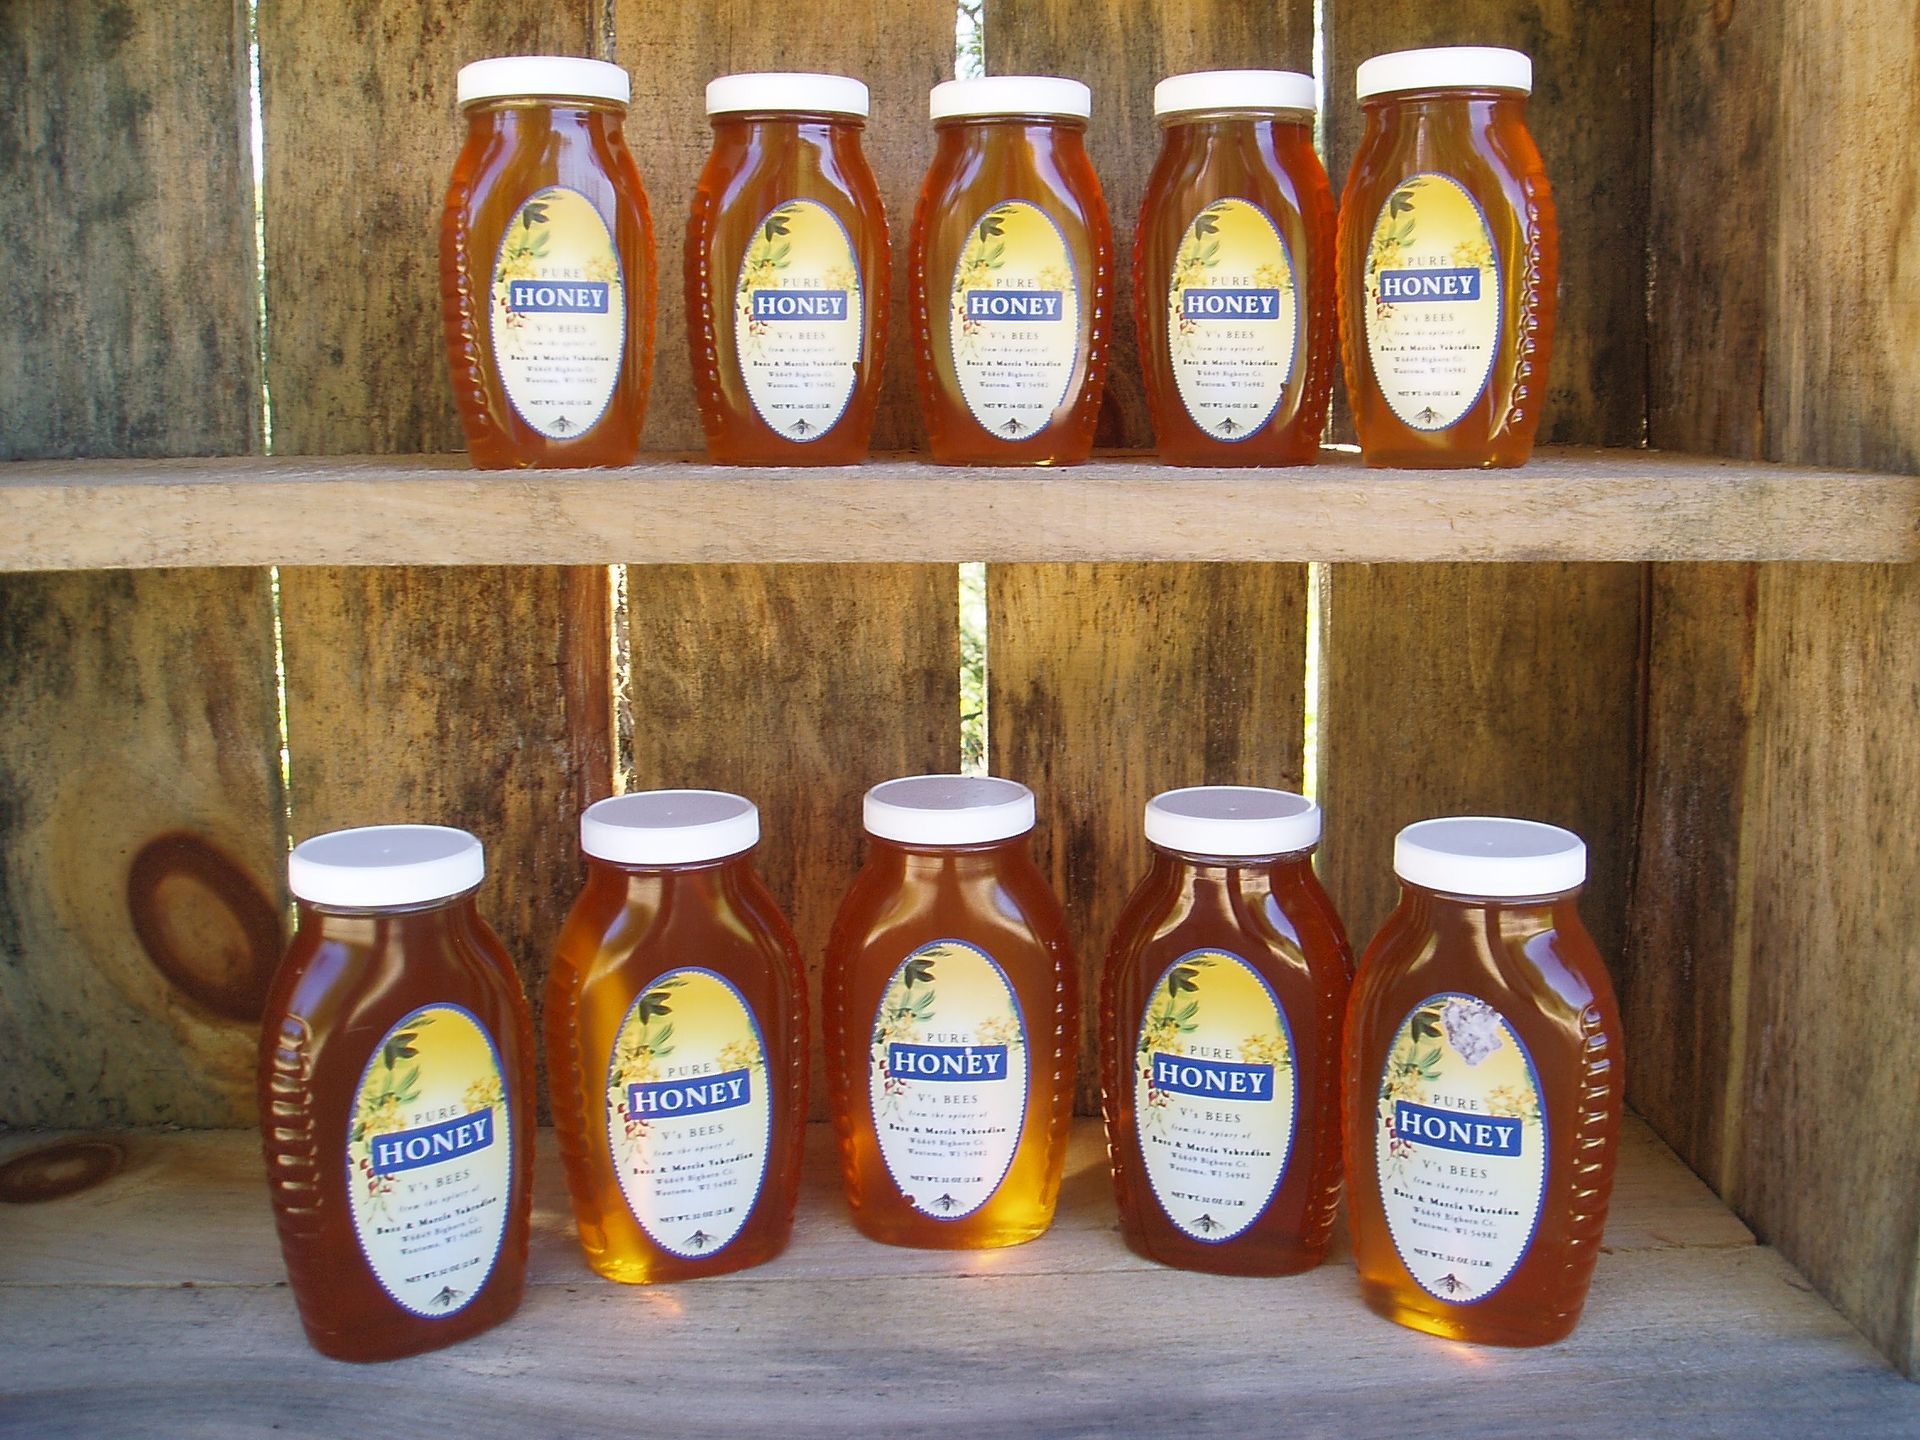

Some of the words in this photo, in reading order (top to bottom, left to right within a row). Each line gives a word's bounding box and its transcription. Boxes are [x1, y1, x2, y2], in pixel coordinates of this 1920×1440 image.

[1408, 256, 1446, 267] PURE
[542, 268, 580, 278] PURE
[1212, 276, 1248, 286] PURE
[783, 278, 819, 287] PURE
[997, 279, 1033, 288] PURE
[1384, 276, 1474, 297] HONEY
[515, 288, 604, 308] HONEY
[758, 298, 843, 315] HONEY
[971, 298, 1057, 315] HONEY
[1187, 296, 1274, 314] HONEY
[927, 1033, 969, 1043] PURE
[1190, 1045, 1233, 1059] PURE
[668, 1062, 711, 1078] PURE
[894, 1052, 1001, 1075] HONEY
[1158, 1062, 1266, 1094] HONEY
[634, 1078, 743, 1113] HONEY
[944, 1094, 978, 1104] BEES
[1433, 1094, 1478, 1111] PURE
[414, 1104, 458, 1125] PURE
[1205, 1111, 1242, 1123] BEES
[689, 1122, 725, 1138] BEES
[1400, 1110, 1514, 1149] HONEY
[378, 1118, 487, 1167] HONEY
[436, 1168, 471, 1188] BEES
[1450, 1164, 1488, 1180] BEES
